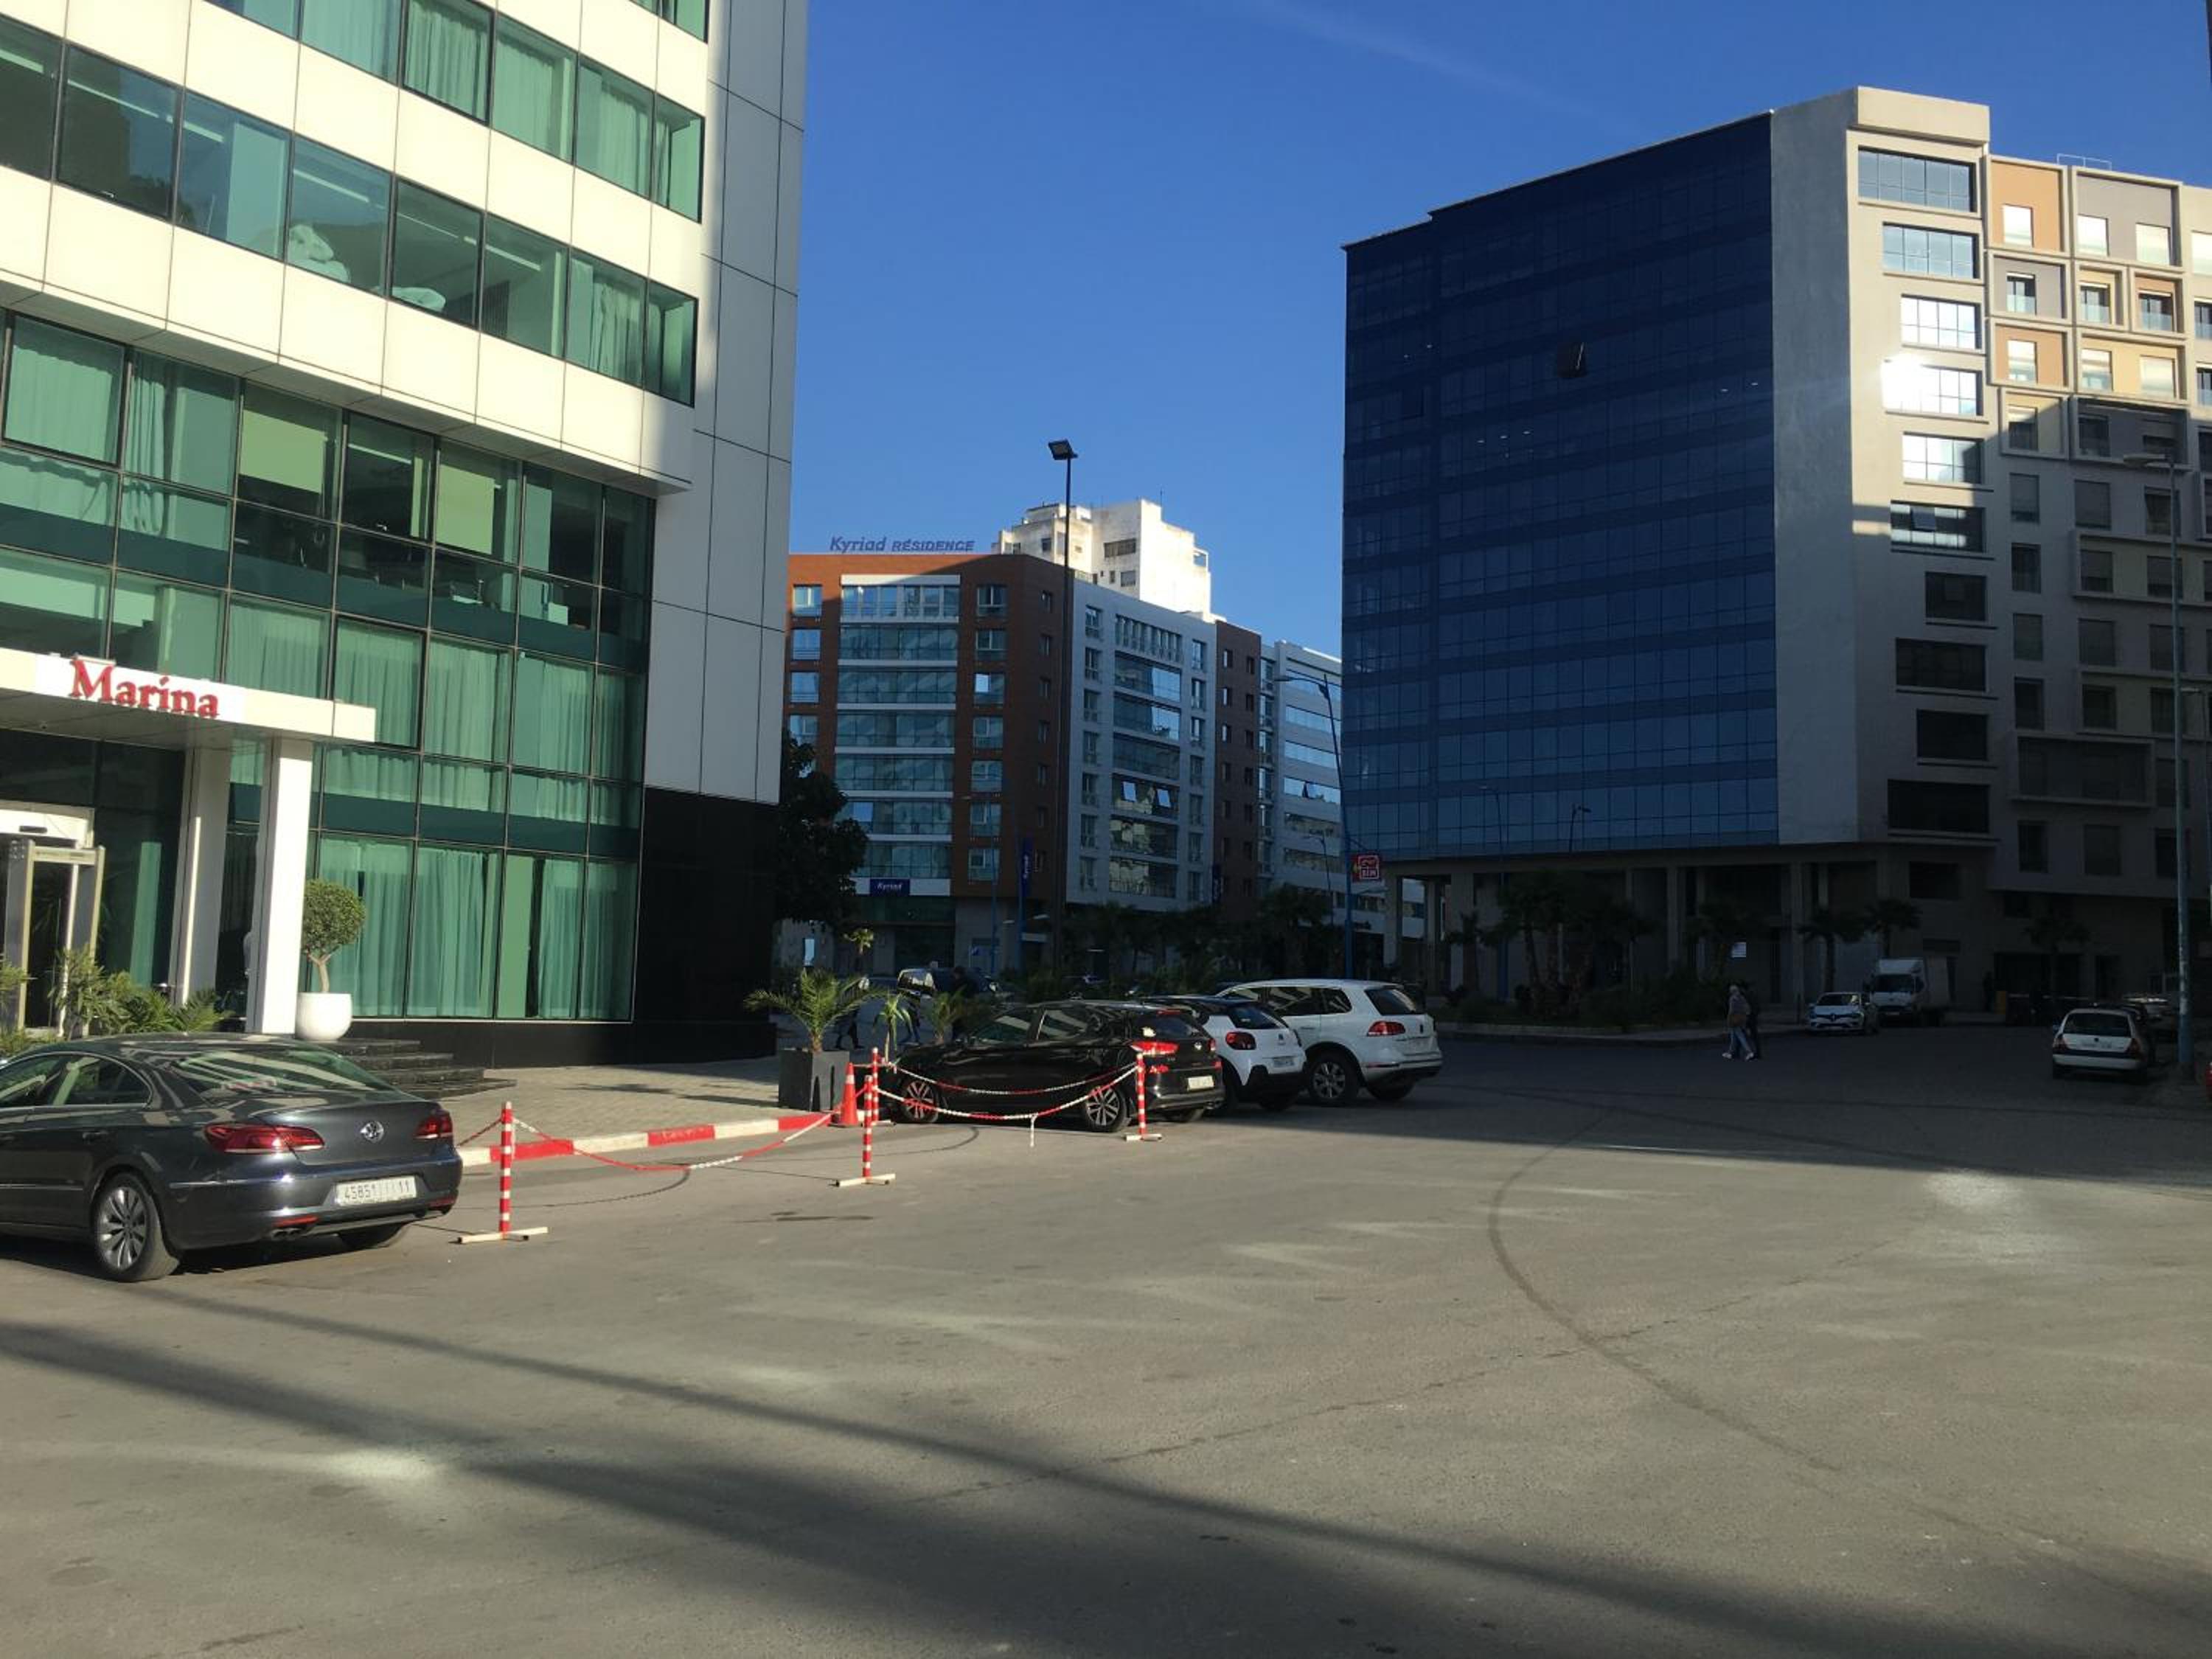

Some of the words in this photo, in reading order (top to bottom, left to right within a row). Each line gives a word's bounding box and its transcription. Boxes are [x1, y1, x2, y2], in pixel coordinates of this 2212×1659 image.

[830, 536, 886, 553] Kyriad
[891, 539, 975, 552] RÉSIDENCE
[70, 658, 219, 719] Marina
